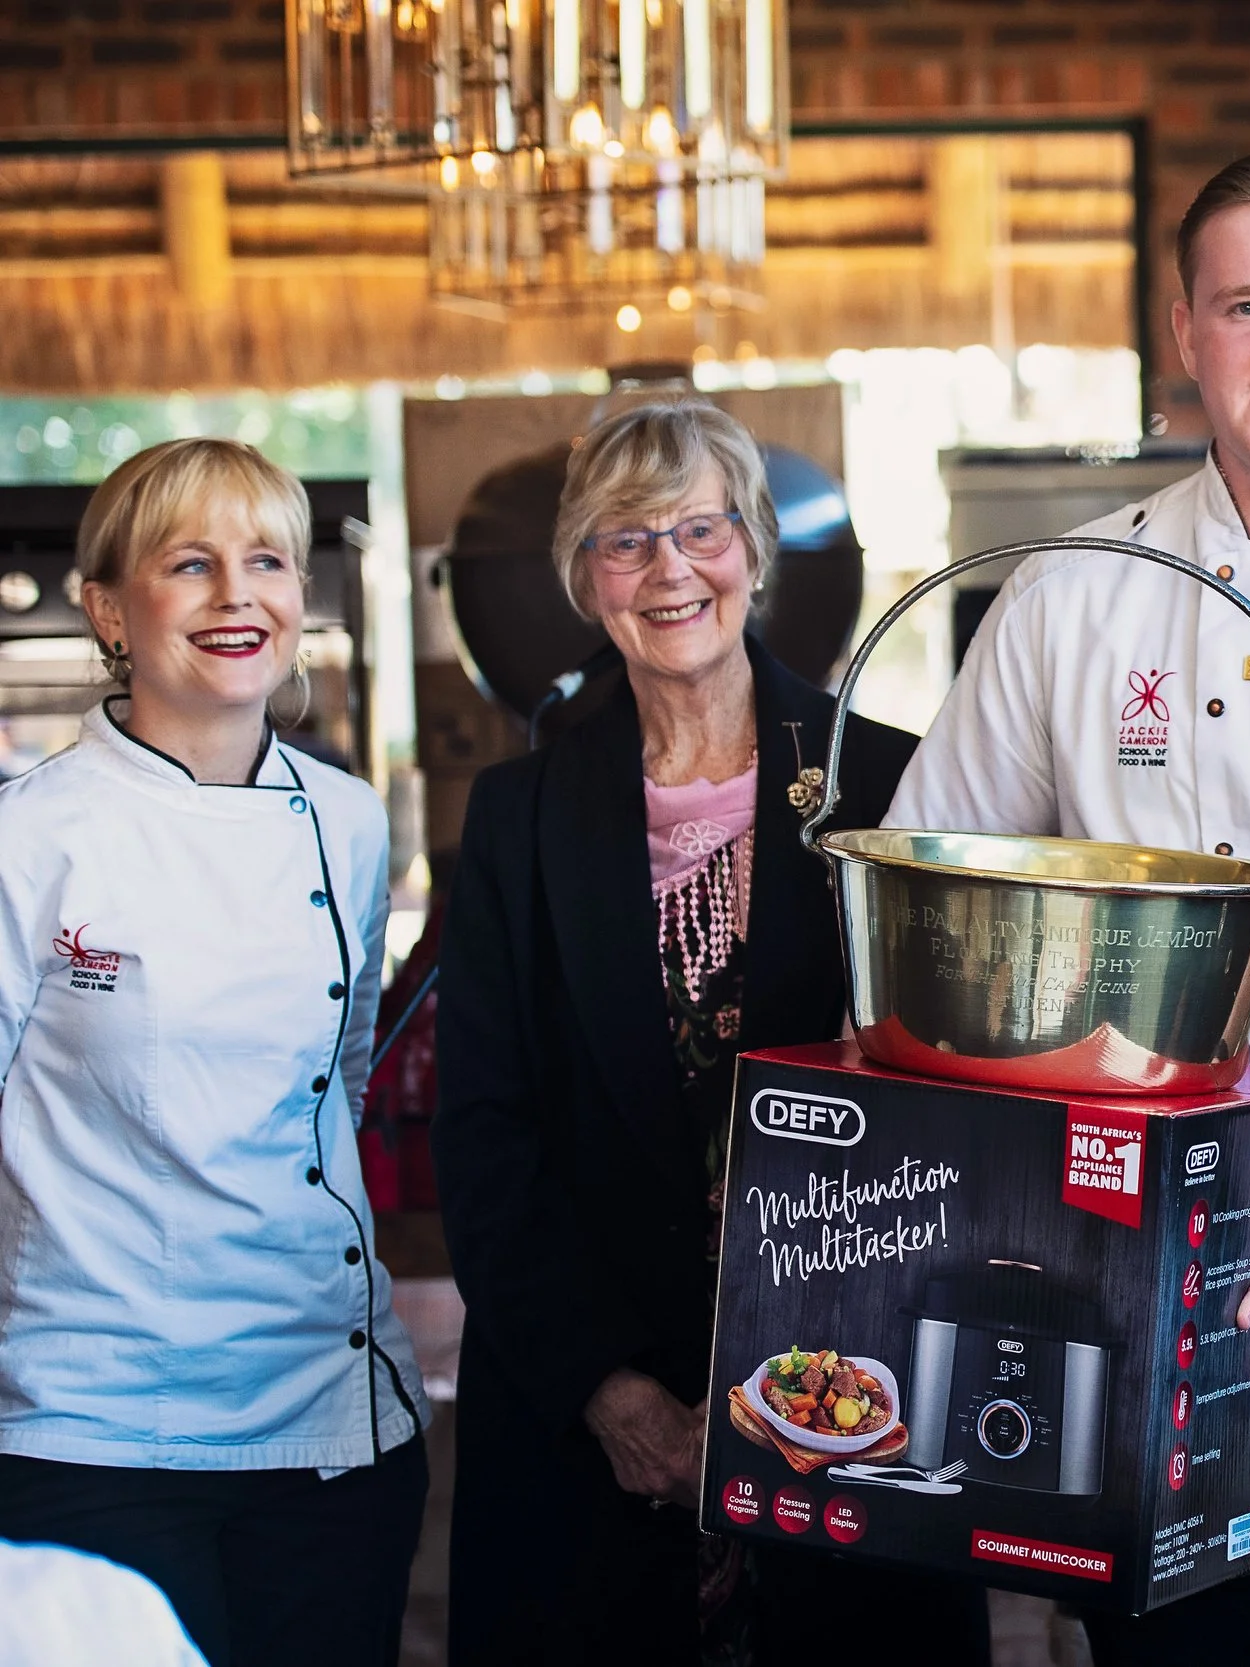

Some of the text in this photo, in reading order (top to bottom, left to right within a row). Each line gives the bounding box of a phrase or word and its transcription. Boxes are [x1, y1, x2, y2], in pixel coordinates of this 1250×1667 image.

[1119, 726, 1168, 736] JACKIE
[1119, 737, 1167, 746] CAMERON
[1118, 747, 1167, 757] SCHOOL OF
[1118, 758, 1139, 766] FOOD
[72, 970, 117, 982] SCHOOL OF
[70, 980, 89, 989] FOOD
[768, 1099, 848, 1135] DEFY
[1071, 1123, 1142, 1141] SOUTH AFRICA'S
[1190, 1150, 1216, 1168] DEFY
[1070, 1159, 1123, 1176] APPLIANCE
[1068, 1170, 1121, 1191] BRAND
[746, 1156, 960, 1234] Multifunction
[1194, 1213, 1205, 1234] 10
[1212, 1213, 1219, 1224] 10
[1219, 1209, 1240, 1221] Cooking
[758, 1202, 949, 1287] Multitasker!
[1236, 1258, 1249, 1269] Soup
[1205, 1280, 1216, 1291] Rice
[1210, 1331, 1218, 1343] Big
[1002, 1342, 1020, 1351] DEFY
[1000, 1360, 1026, 1377] 0:30
[1196, 1389, 1227, 1405] Temperature
[1191, 1448, 1221, 1465] Time setting
[738, 1482, 753, 1496] 10
[729, 1495, 758, 1508] Cooking
[779, 1496, 811, 1510] Pressure
[727, 1503, 759, 1516] Programs
[777, 1507, 811, 1522] Cooking
[838, 1507, 852, 1517] LED
[830, 1516, 859, 1531] Display
[1155, 1525, 1173, 1541] Model:
[1173, 1520, 1187, 1534] DMC
[1154, 1532, 1190, 1555] Power: 1100W
[977, 1539, 1107, 1572] GOURMET MULTICOOKER
[1153, 1553, 1176, 1568] Voltage:
[1175, 1547, 1186, 1561] 220
